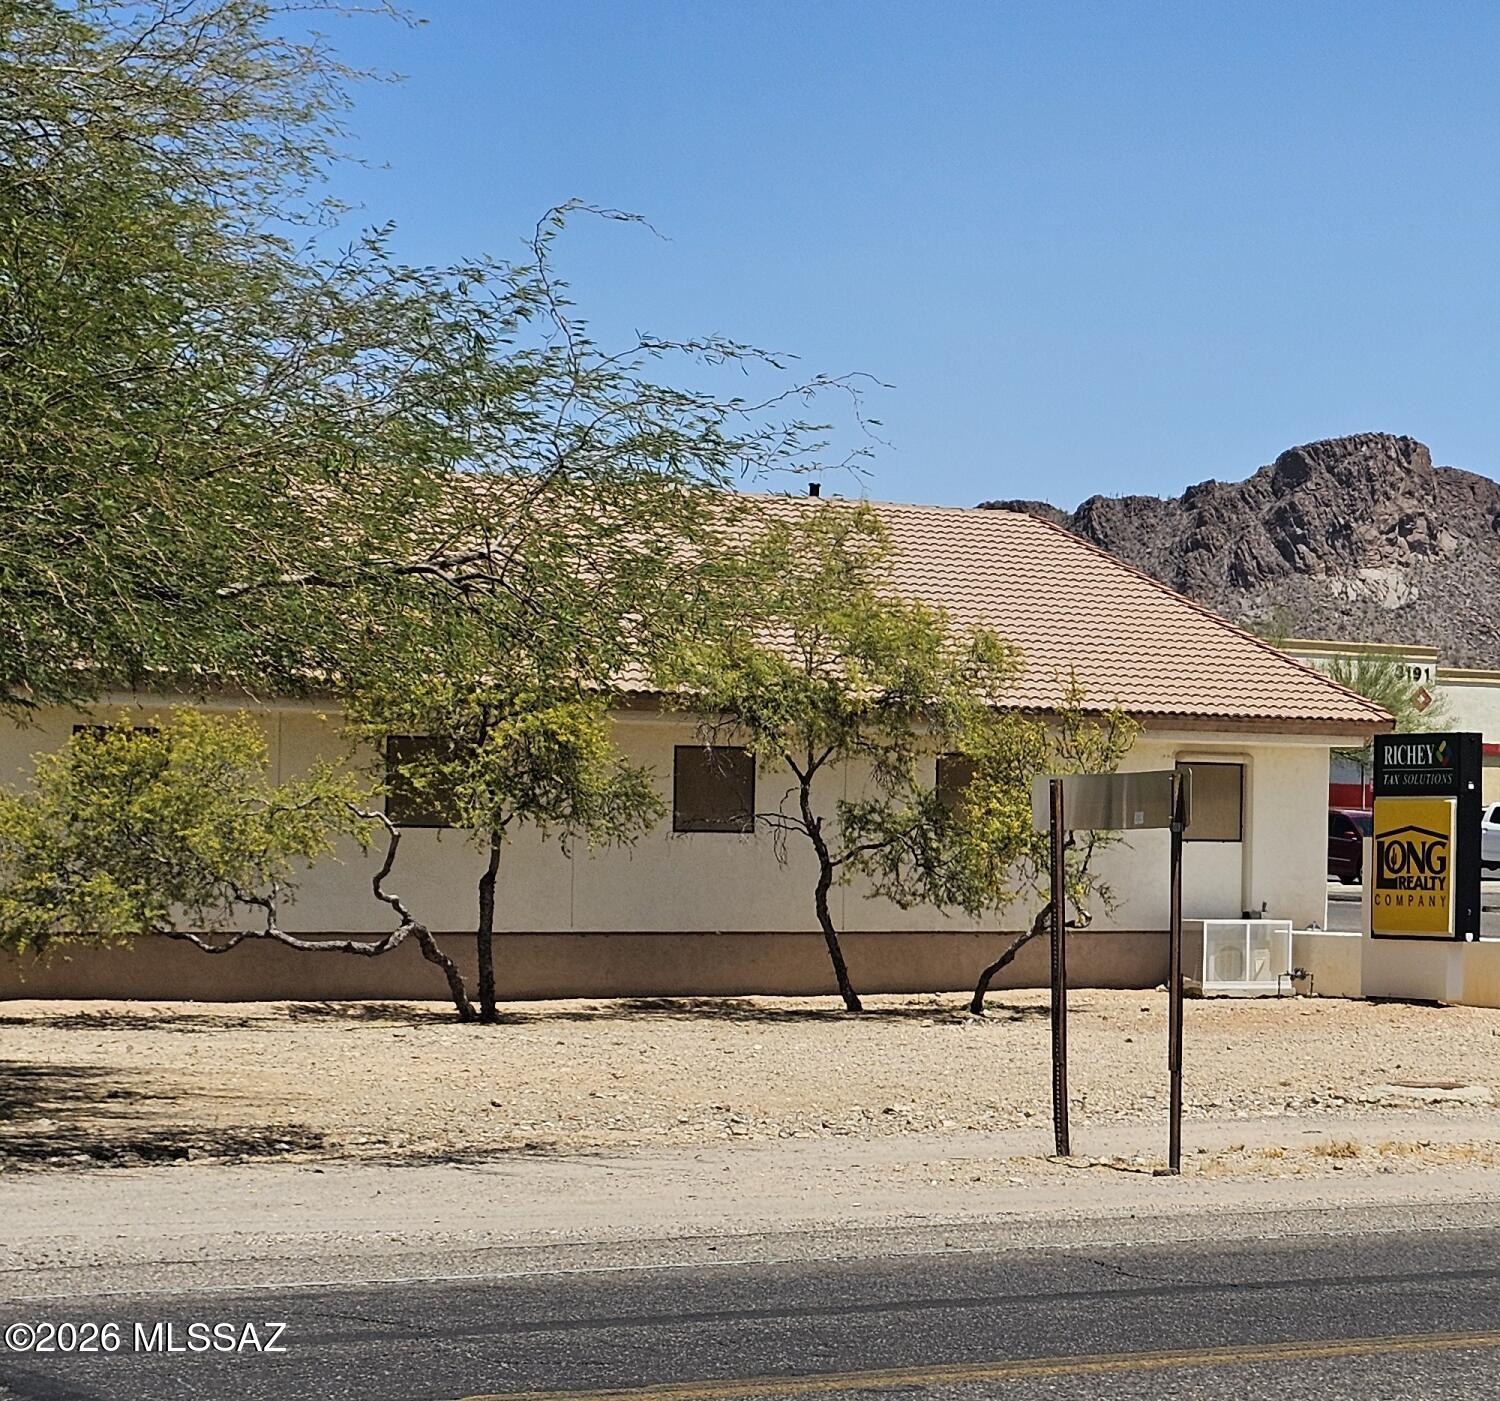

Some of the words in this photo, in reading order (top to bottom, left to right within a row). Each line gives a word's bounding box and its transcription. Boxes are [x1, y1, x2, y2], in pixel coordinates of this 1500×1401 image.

[1396, 664, 1429, 684] 3191
[1384, 745, 1435, 765] RICHEY
[1383, 775, 1400, 786] TAX
[1403, 773, 1453, 785] SOLUTIONS
[1376, 840, 1447, 890] LONG
[1399, 875, 1446, 891] REALTY
[1375, 894, 1447, 907] COMPANY
